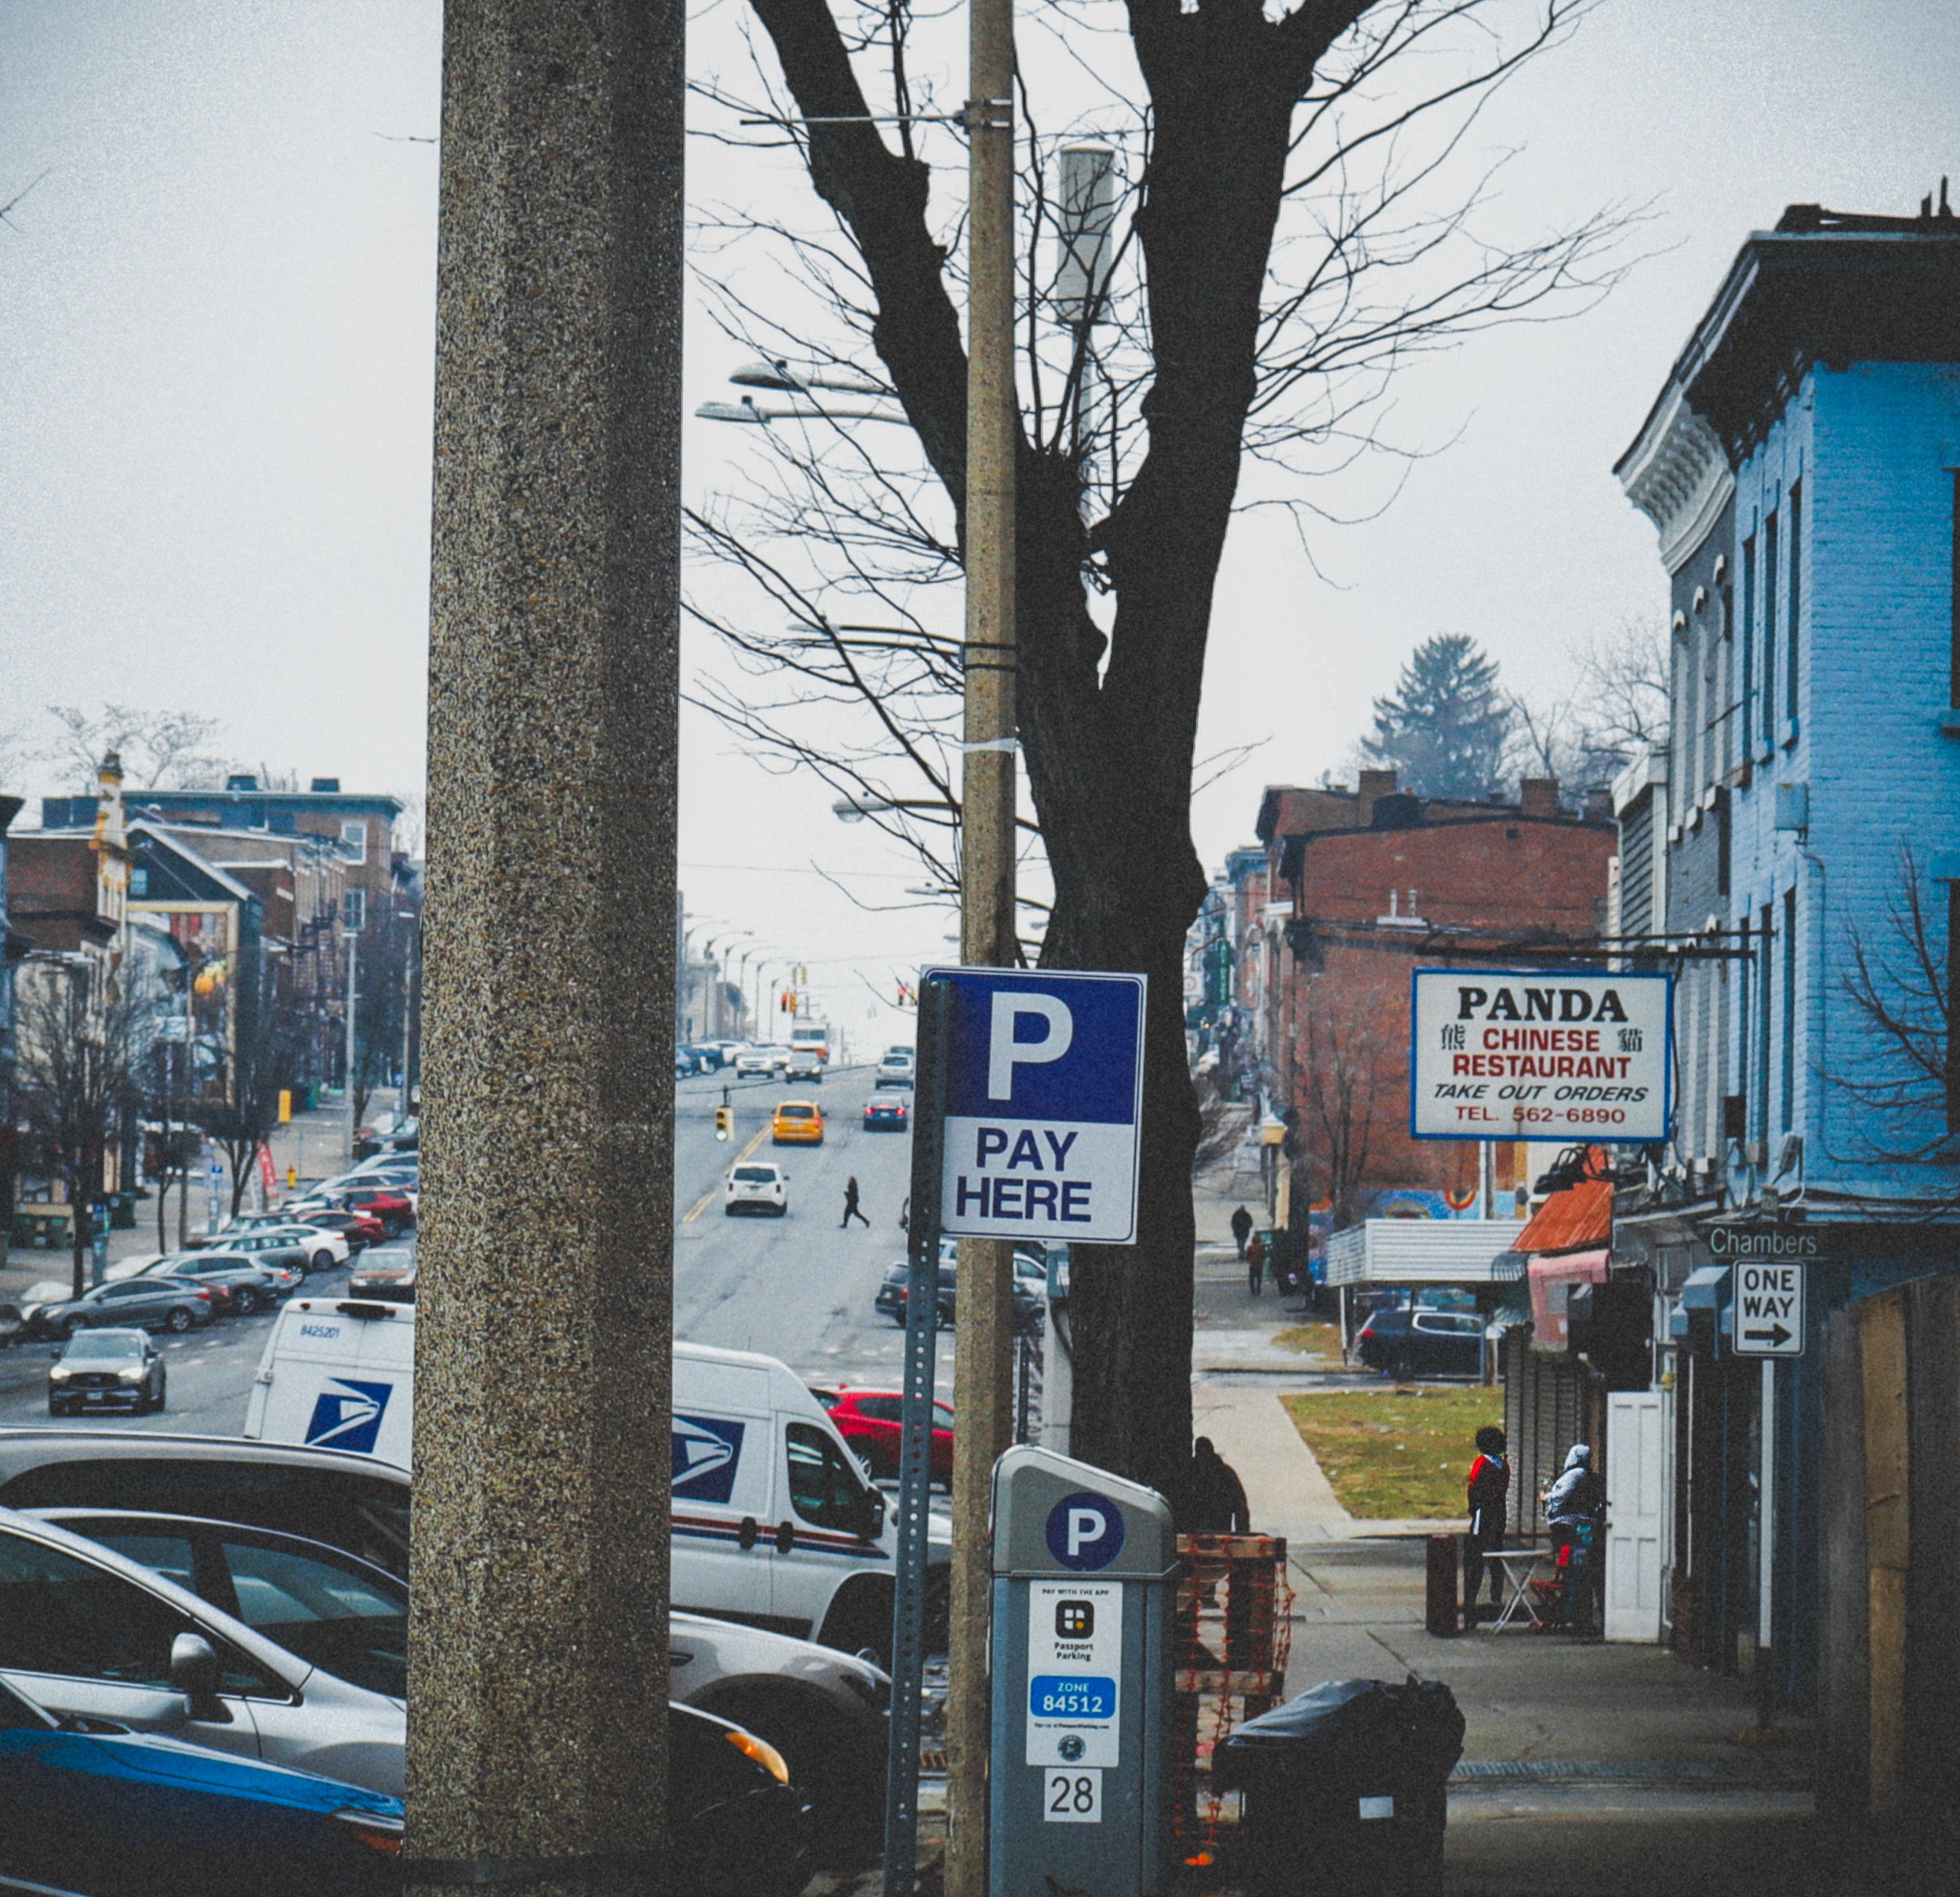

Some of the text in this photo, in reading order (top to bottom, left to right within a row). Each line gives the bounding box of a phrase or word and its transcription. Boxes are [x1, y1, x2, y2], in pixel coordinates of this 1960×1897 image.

[1457, 987, 1628, 1022] PANDA
[988, 992, 1073, 1100] P
[1441, 1025, 1465, 1050] 熊
[1483, 1028, 1600, 1051] CHINESE
[1453, 1054, 1632, 1079] RESTAURANT
[1434, 1084, 1649, 1102] TAKE OUT ORDERS
[1455, 1106, 1625, 1123] TEL. 562-6890
[976, 1127, 1078, 1171] PAY
[956, 1176, 1091, 1222] HERE
[1711, 1228, 1817, 1253] Chambers
[1744, 1269, 1795, 1291] ONE
[1744, 1296, 1795, 1318] WAY
[1068, 1508, 1106, 1556] P
[1054, 1642, 1093, 1652] Passport
[1057, 1652, 1091, 1662] Parking
[1058, 1683, 1089, 1692] ZONE
[1044, 1695, 1102, 1713] 84512
[1051, 1776, 1093, 1813] 28
